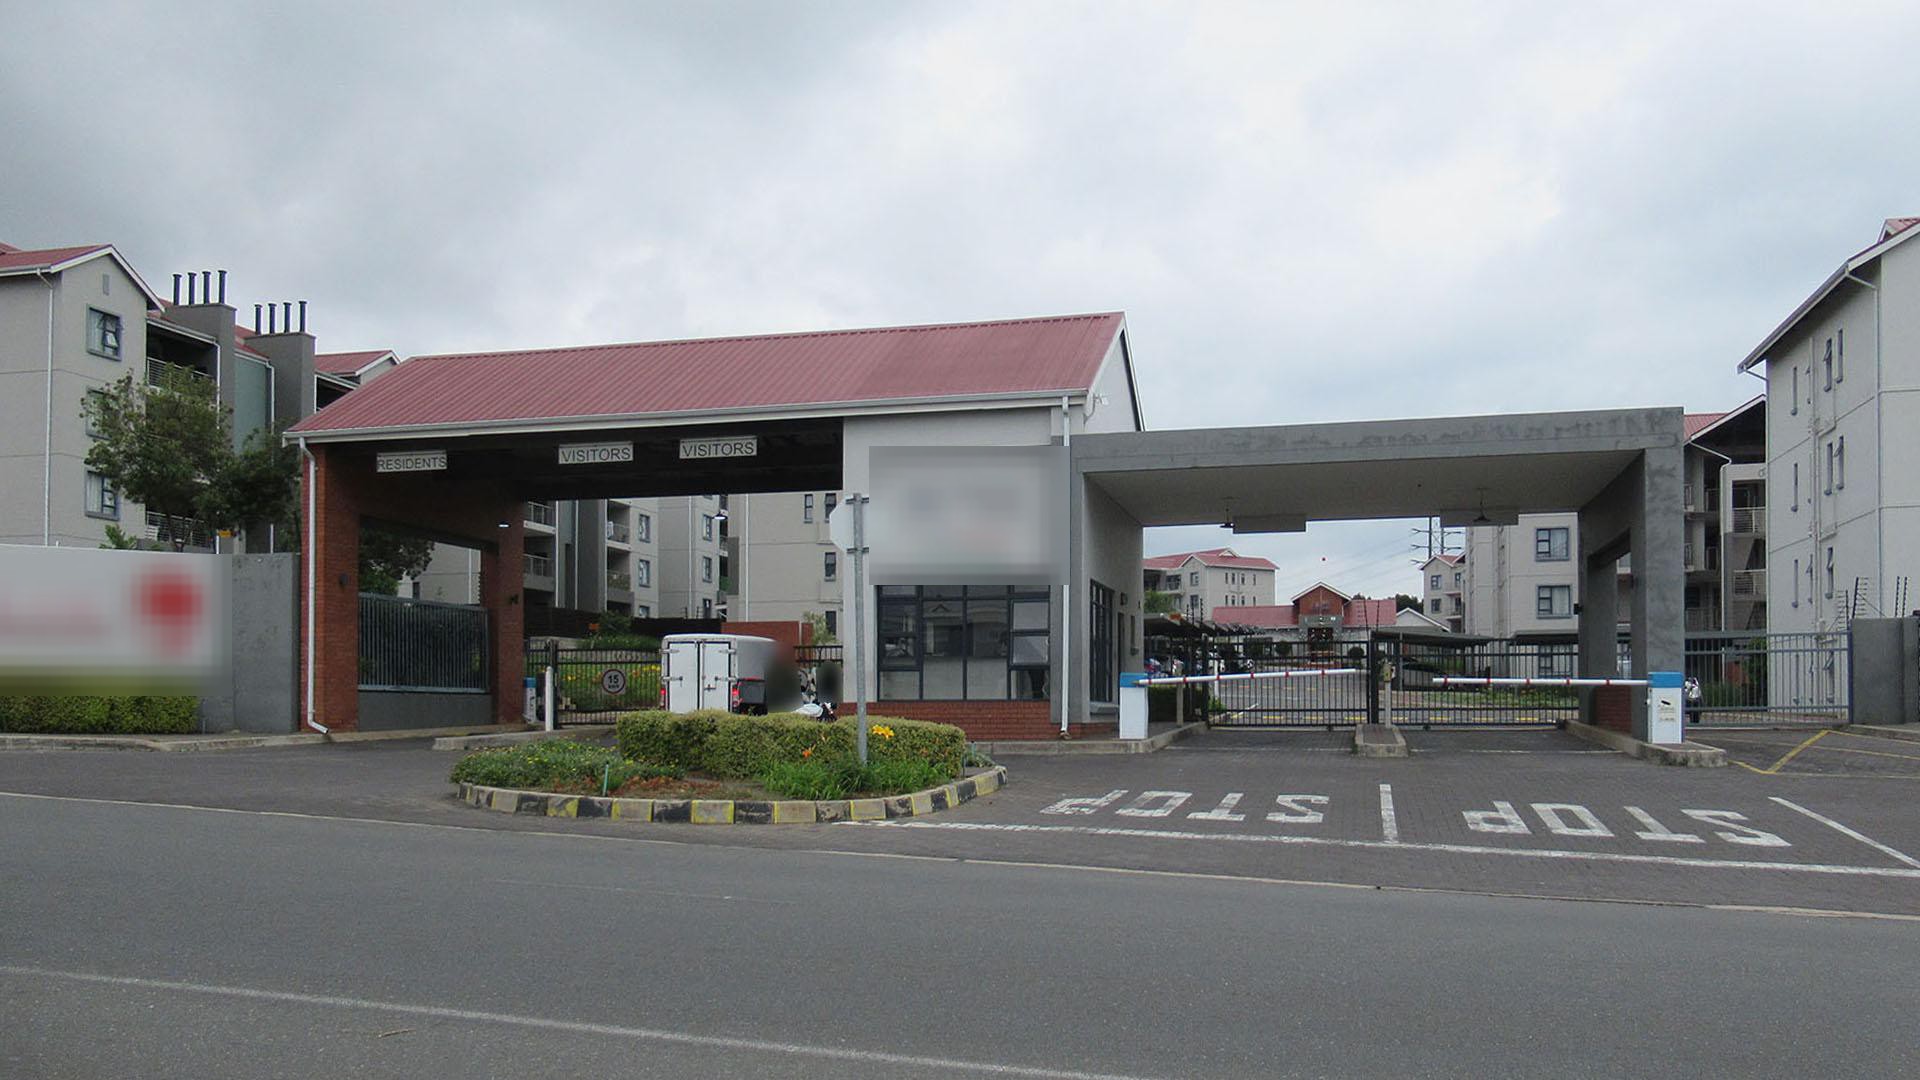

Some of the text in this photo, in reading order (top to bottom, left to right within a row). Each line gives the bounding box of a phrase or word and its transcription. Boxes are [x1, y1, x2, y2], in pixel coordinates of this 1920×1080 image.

[561, 447, 631, 462] VISITORS
[681, 442, 754, 457] VISITORS
[377, 457, 447, 470] RESIDENTS
[608, 674, 620, 684] 15
[1039, 789, 1330, 823] STOP
[1462, 801, 1792, 848] STOP
